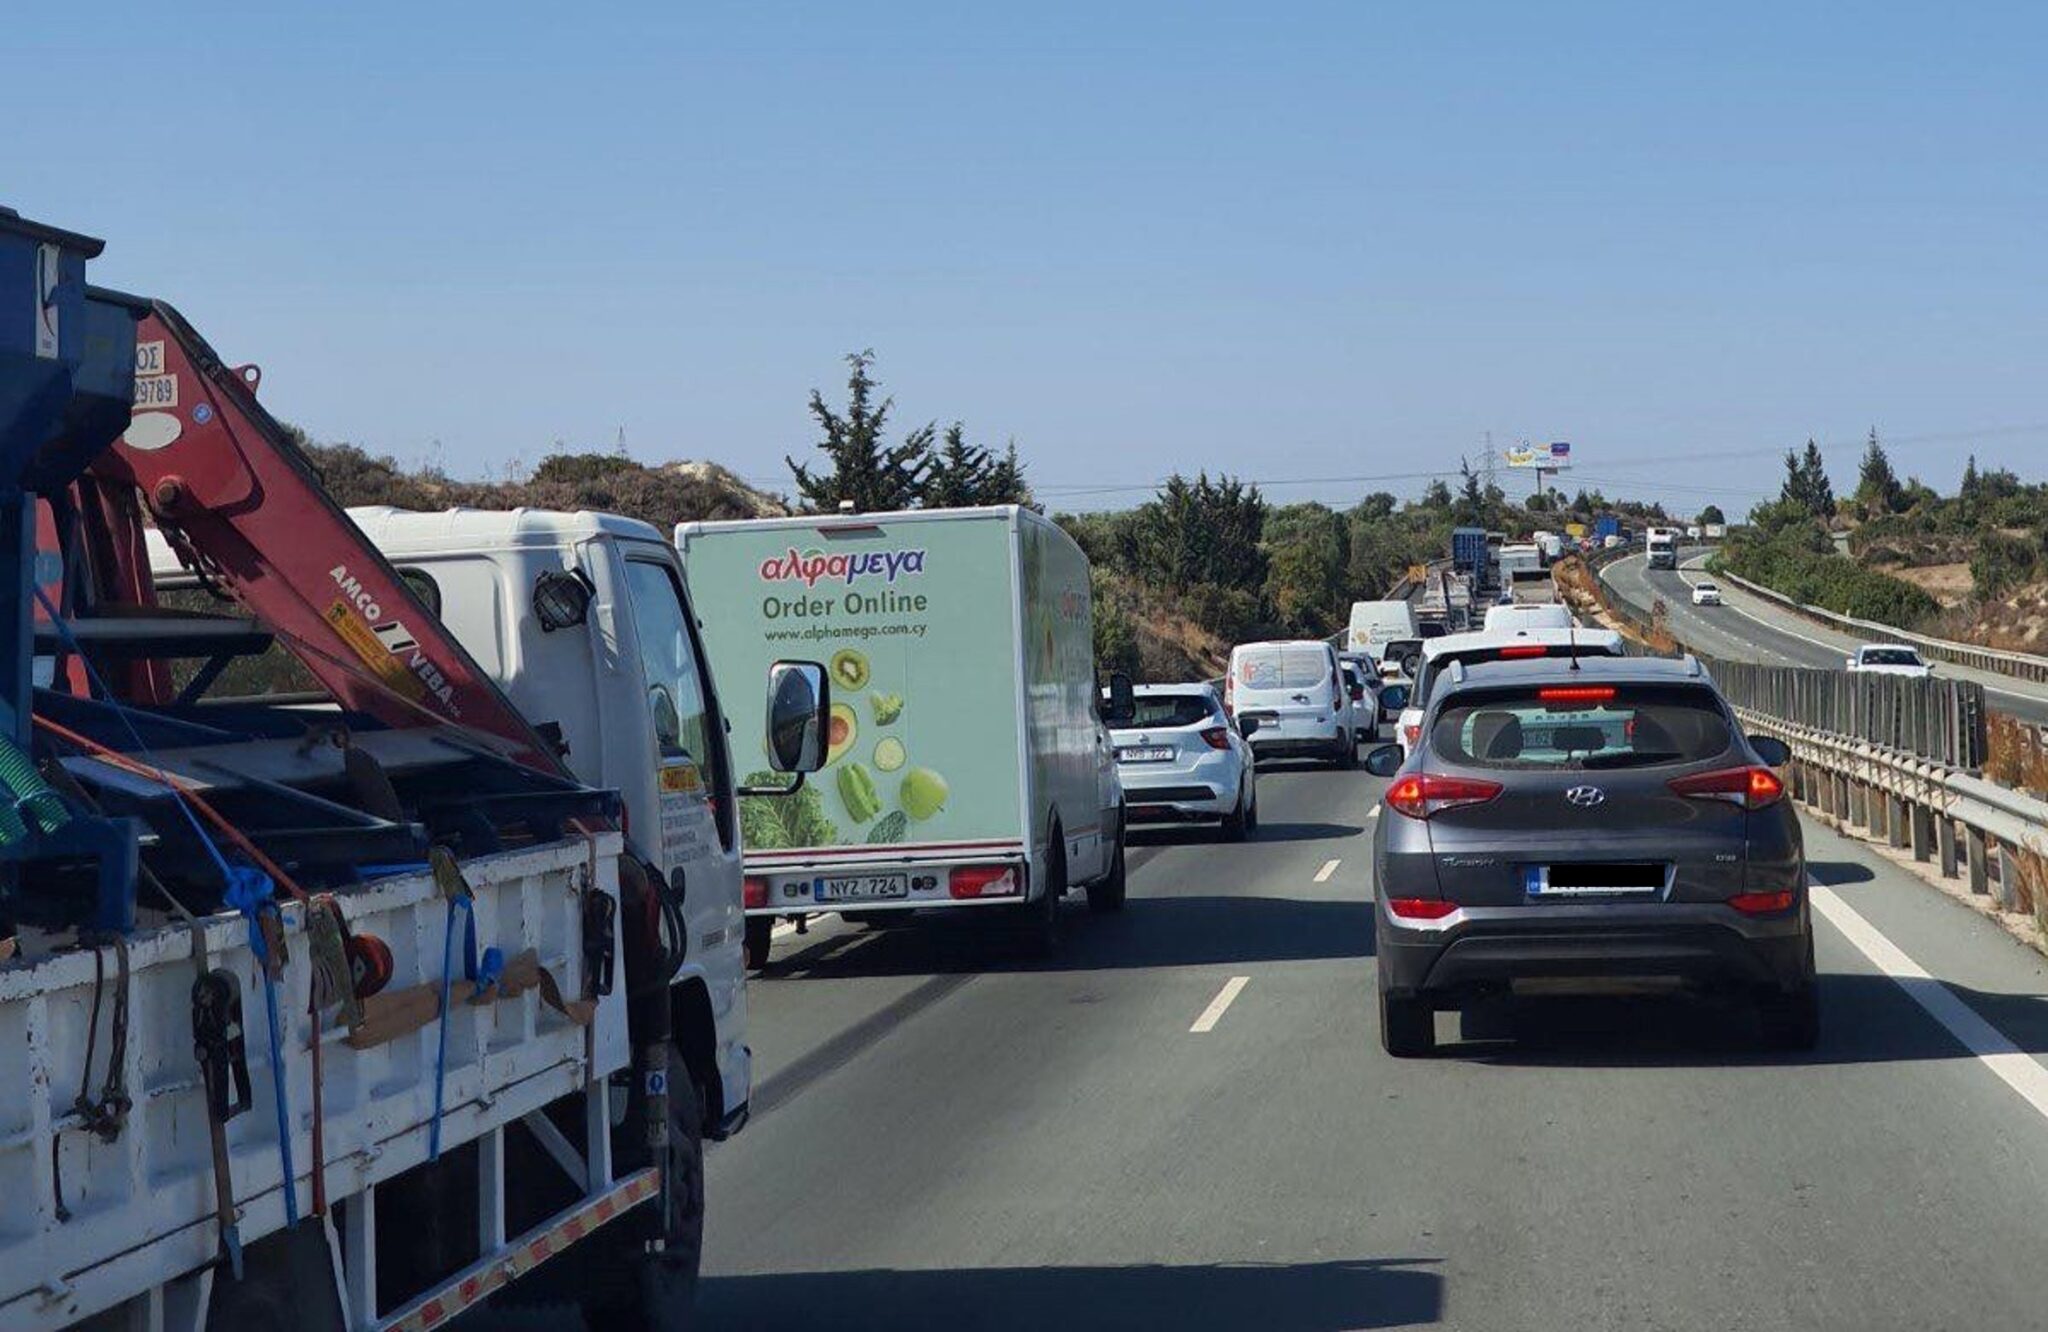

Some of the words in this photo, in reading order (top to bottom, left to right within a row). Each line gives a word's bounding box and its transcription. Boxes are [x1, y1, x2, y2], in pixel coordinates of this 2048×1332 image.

[760, 549, 926, 588] αλφαμεγα
[762, 594, 835, 620] Order
[843, 590, 928, 615] Online
[329, 564, 381, 621] AMCO
[410, 650, 453, 703] VEBA
[764, 622, 928, 643] www.alphamega.com.cy
[829, 880, 861, 896] NYZ
[868, 878, 898, 894] 724
